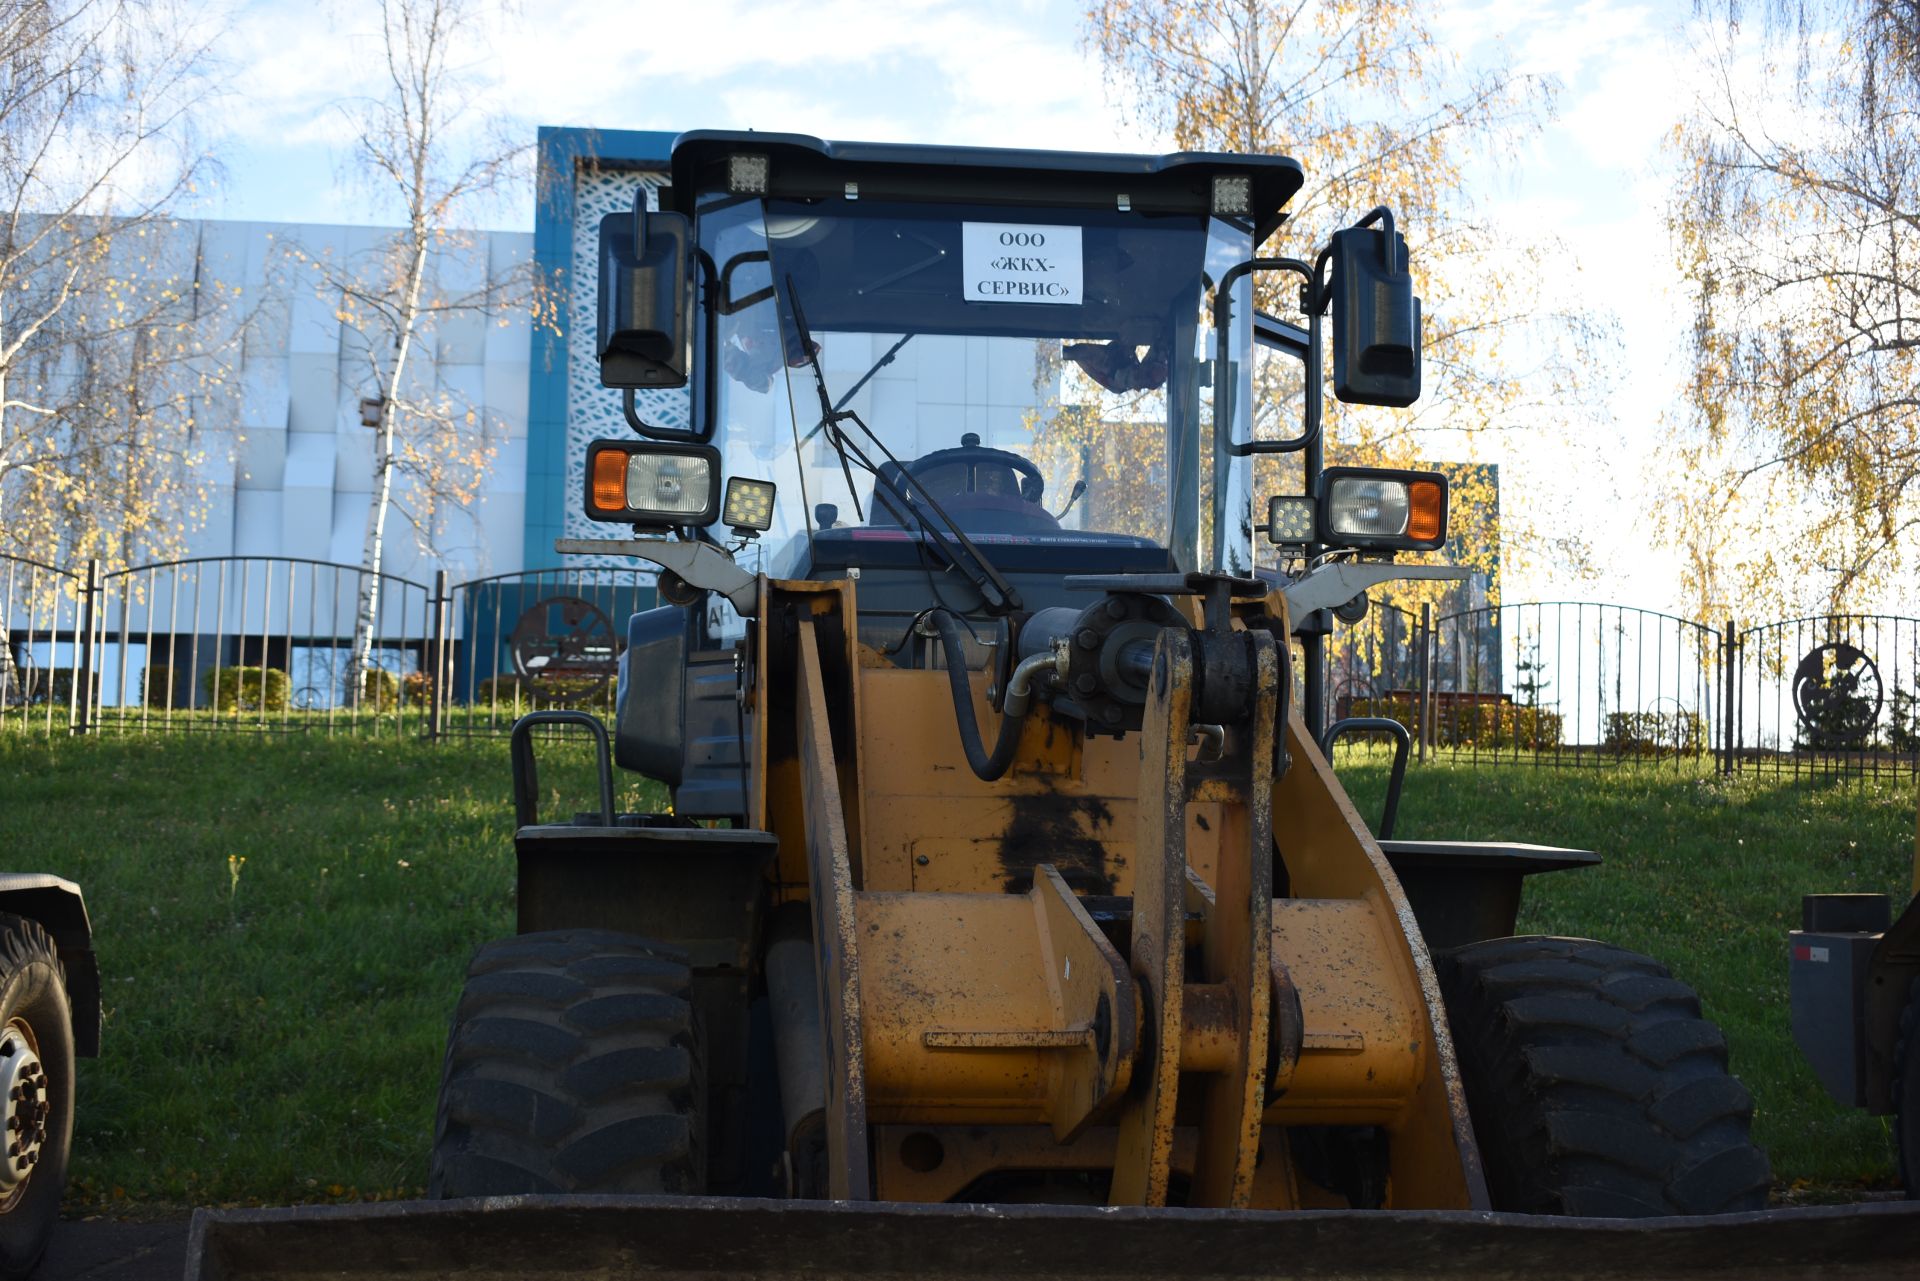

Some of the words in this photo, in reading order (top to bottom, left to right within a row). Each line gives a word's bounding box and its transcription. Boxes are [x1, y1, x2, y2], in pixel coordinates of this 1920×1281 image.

[999, 232, 1045, 247] ООО
[990, 257, 1056, 272] «ЖКХ-
[977, 280, 1069, 296] СЕРВИС»
